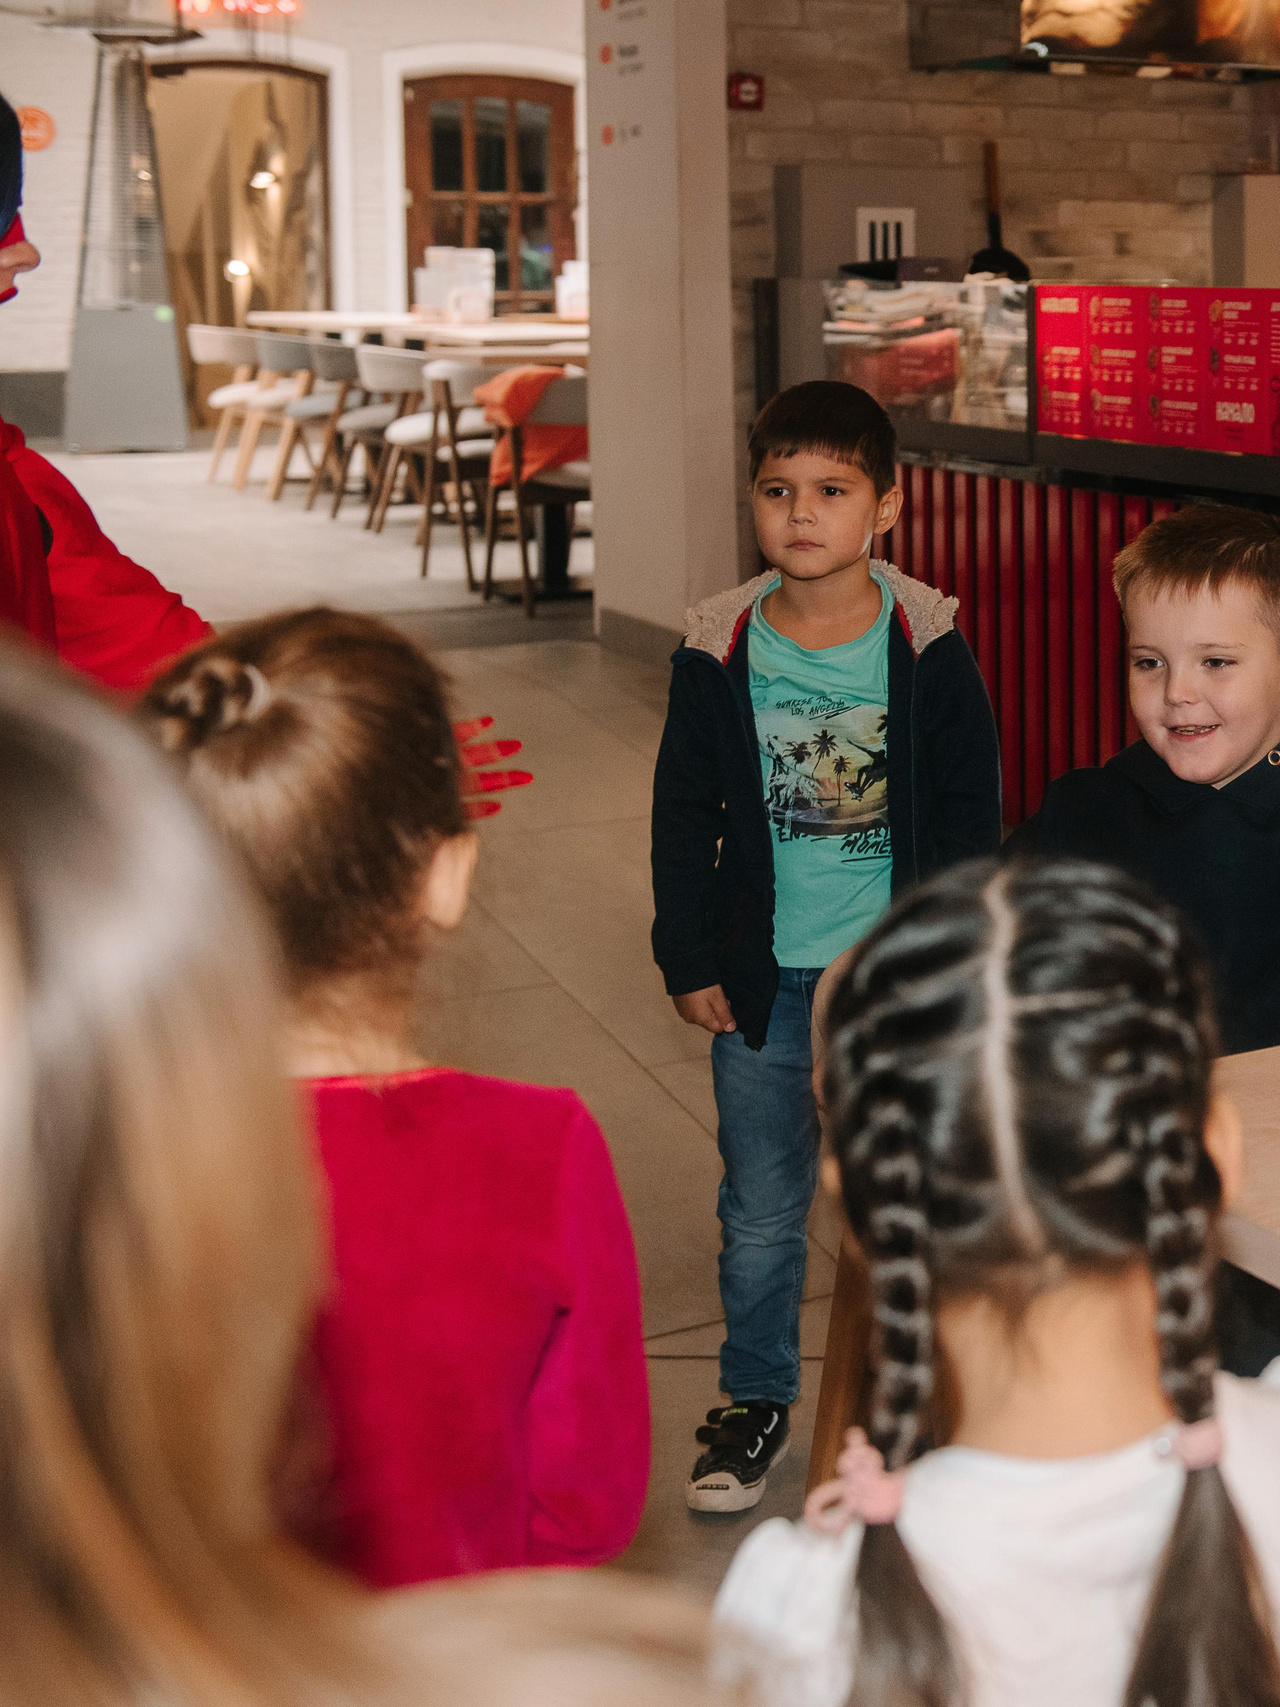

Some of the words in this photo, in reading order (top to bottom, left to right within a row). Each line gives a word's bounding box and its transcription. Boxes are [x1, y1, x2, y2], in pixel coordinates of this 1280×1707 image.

[776, 697, 813, 709] SUNRISE
[791, 706, 804, 716] LOS
[840, 838, 892, 855] MOME
